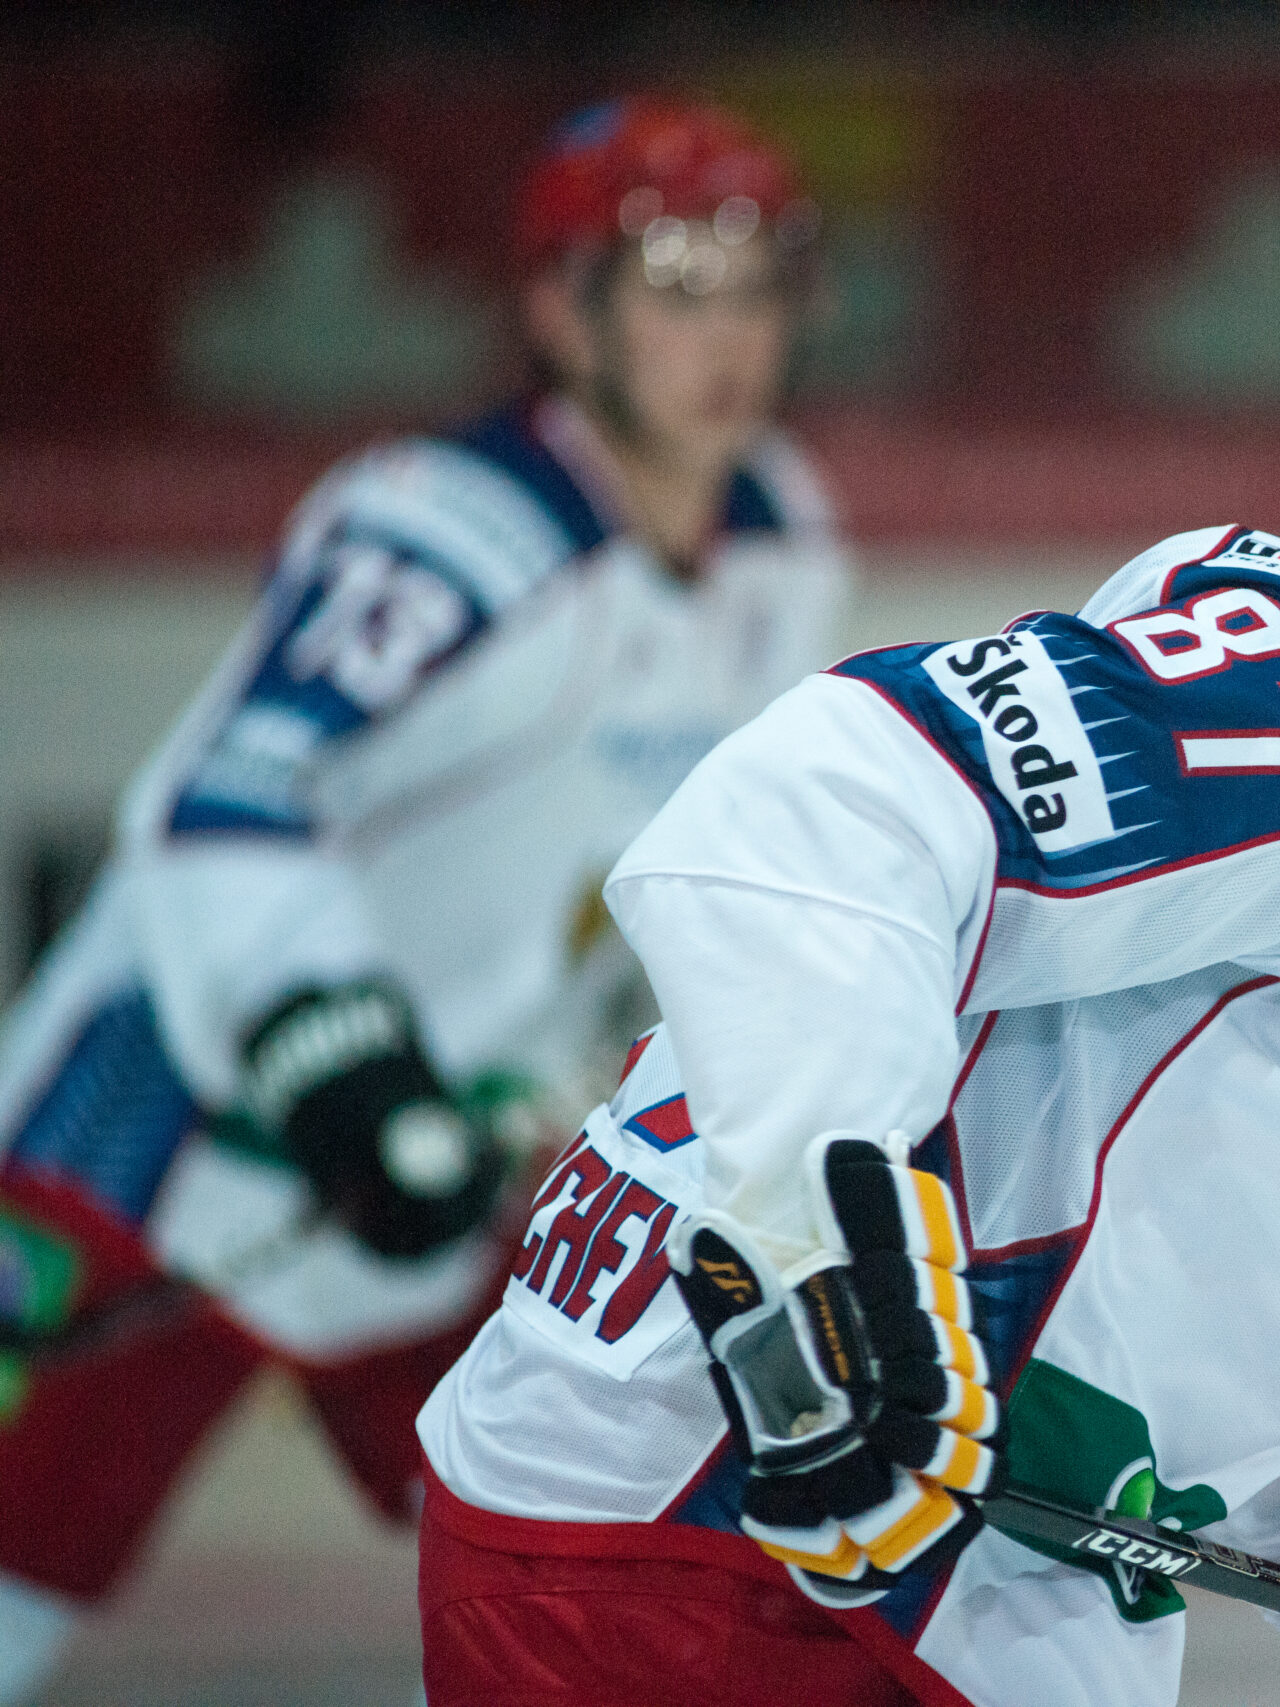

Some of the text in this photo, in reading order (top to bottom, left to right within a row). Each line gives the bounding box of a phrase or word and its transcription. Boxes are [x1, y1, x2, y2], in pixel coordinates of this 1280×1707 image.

[947, 633, 1079, 835] Škoda
[511, 1128, 696, 1346] CHEV
[1086, 1528, 1191, 1576] CCM
